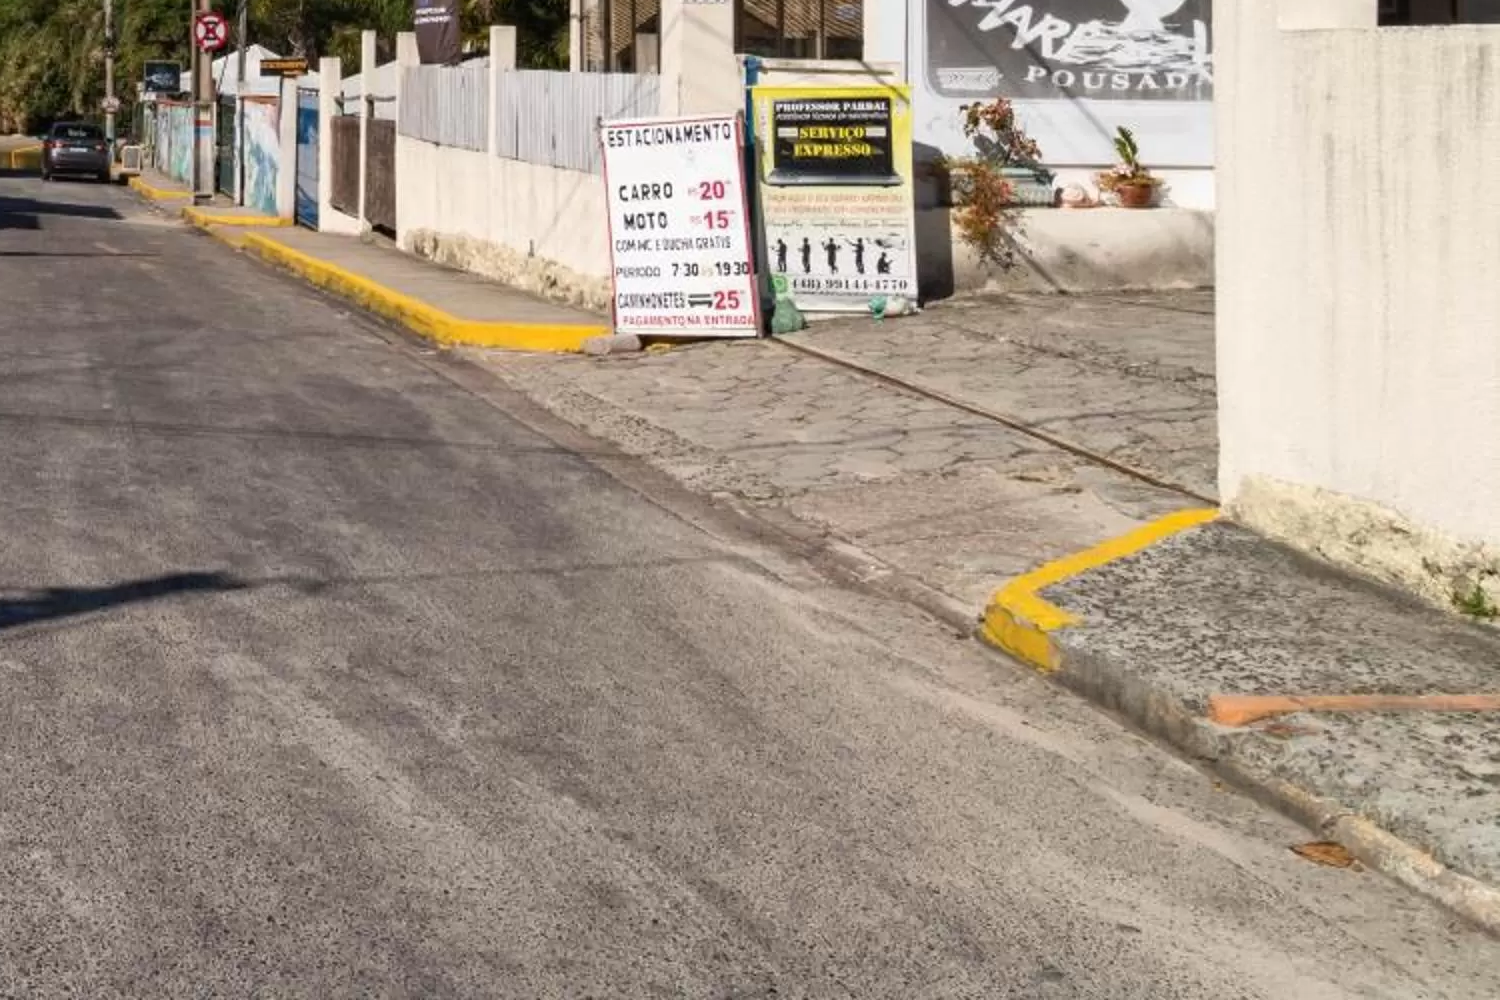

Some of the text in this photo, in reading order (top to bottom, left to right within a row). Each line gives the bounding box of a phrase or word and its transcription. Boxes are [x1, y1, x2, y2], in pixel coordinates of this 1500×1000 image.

[607, 122, 732, 148] ESTACIONAMENTO
[799, 126, 865, 142] SERVIÇO
[793, 143, 871, 157] EXPRESSO
[618, 181, 674, 202] CARRO
[623, 211, 669, 231] MOTO
[615, 238, 636, 253] COM
[655, 238, 661, 251] E
[617, 291, 685, 310] CAMINHONETES
[623, 314, 754, 326] PAGAMENTO NA ENTRADA
